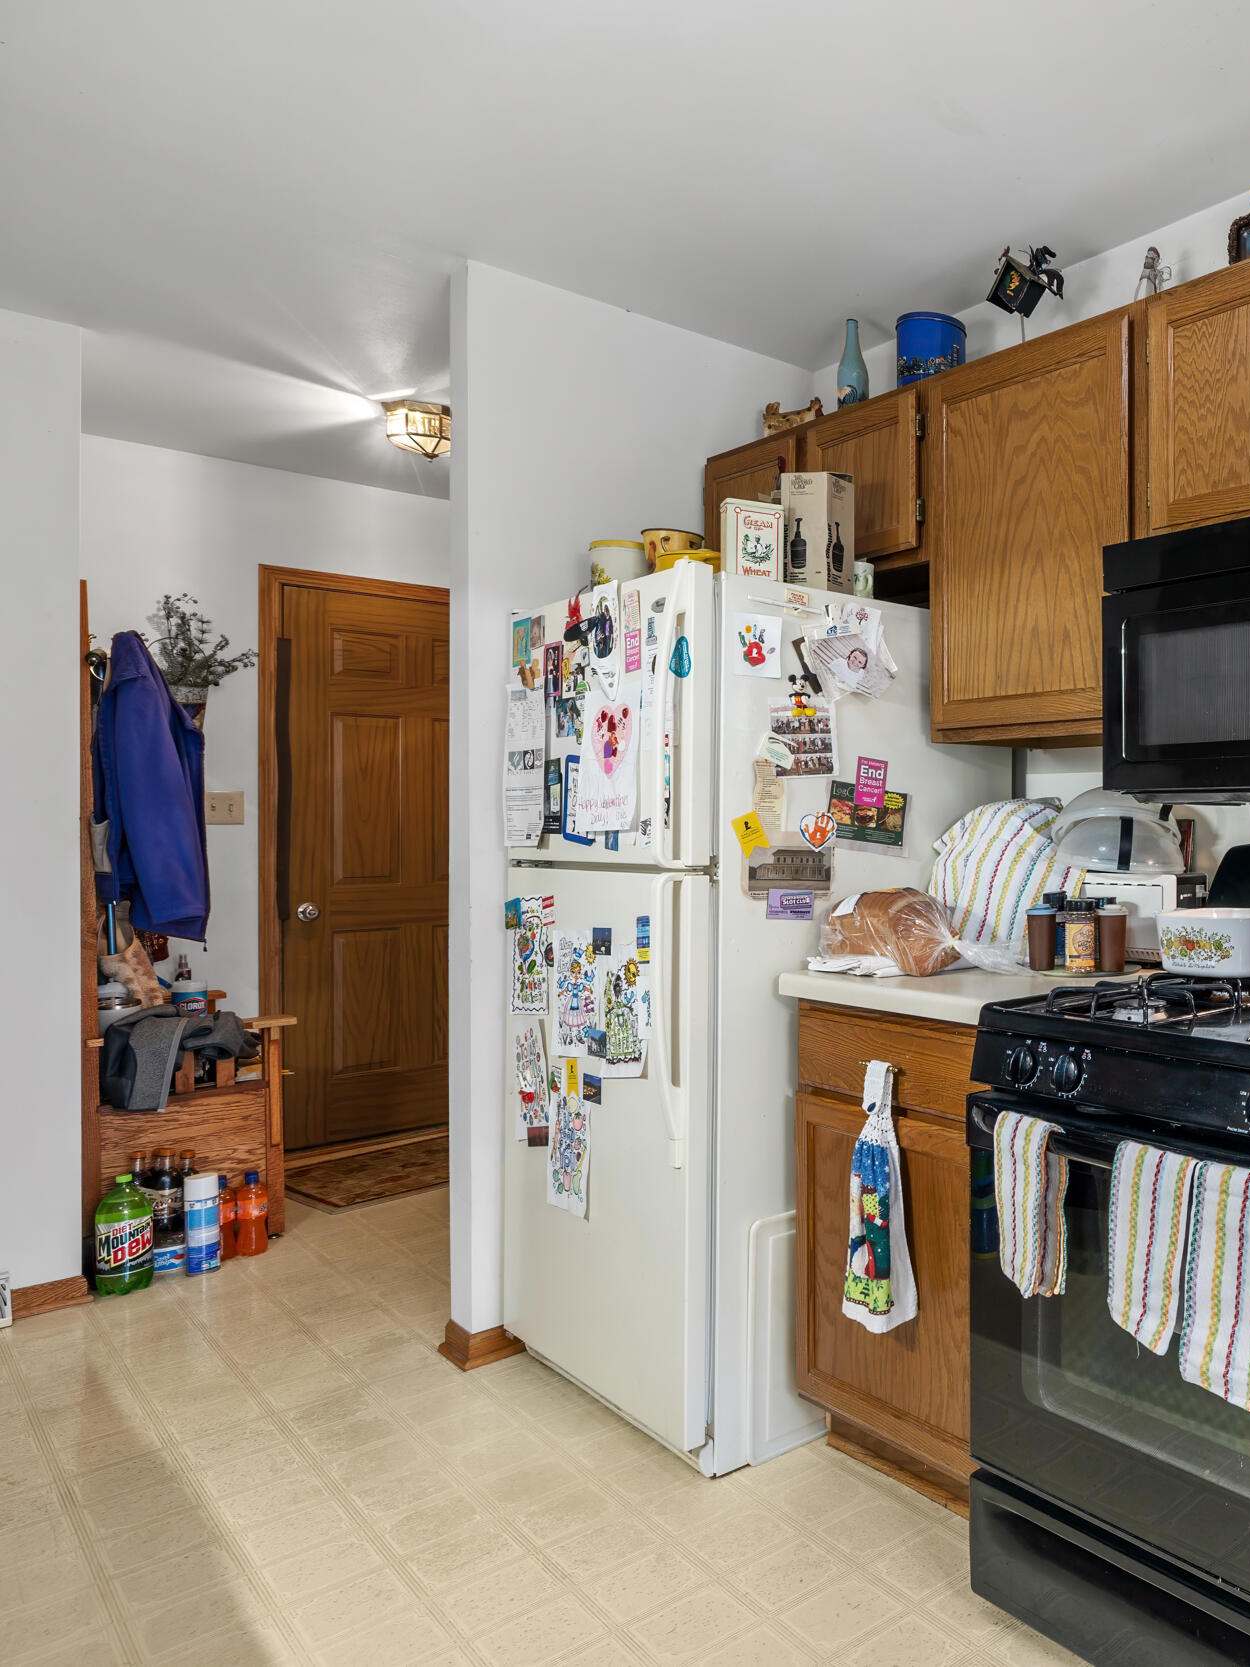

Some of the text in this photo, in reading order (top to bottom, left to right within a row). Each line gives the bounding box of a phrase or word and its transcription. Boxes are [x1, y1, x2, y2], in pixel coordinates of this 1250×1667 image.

[742, 565, 772, 577] WHEAT
[860, 765, 885, 779] End
[859, 776, 883, 787] Breast
